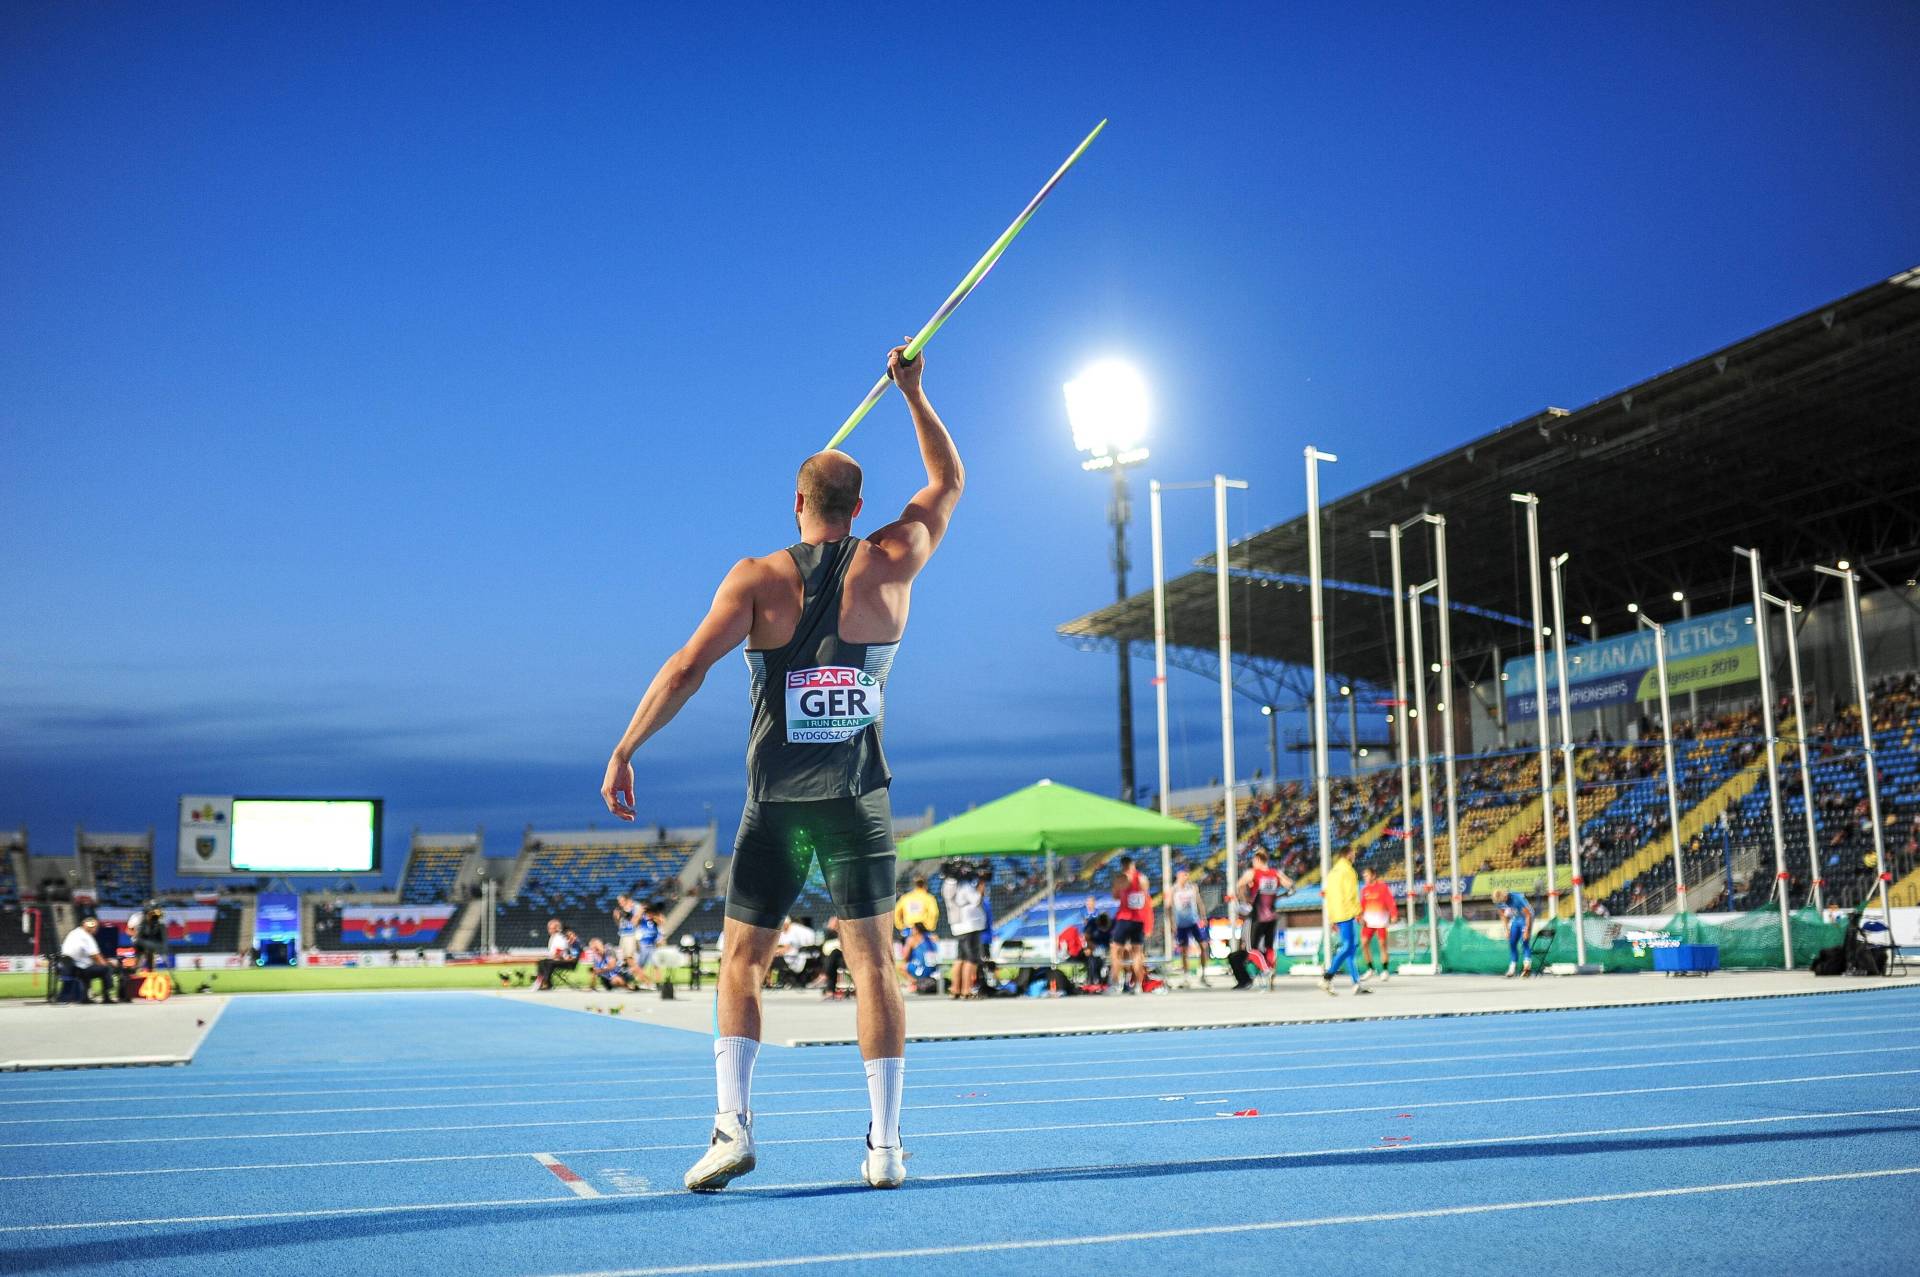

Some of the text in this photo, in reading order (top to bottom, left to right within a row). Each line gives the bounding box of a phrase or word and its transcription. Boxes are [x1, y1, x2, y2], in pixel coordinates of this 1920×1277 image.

[1630, 619, 1737, 664] ATLETICS
[1711, 655, 1739, 676] 2019
[790, 671, 854, 686] SPAR
[800, 689, 870, 717] GER
[1518, 696, 1545, 715] TEA
[812, 720, 830, 728] RUN
[792, 730, 854, 741] BYDGOSZCZ
[139, 974, 169, 1000] 40
